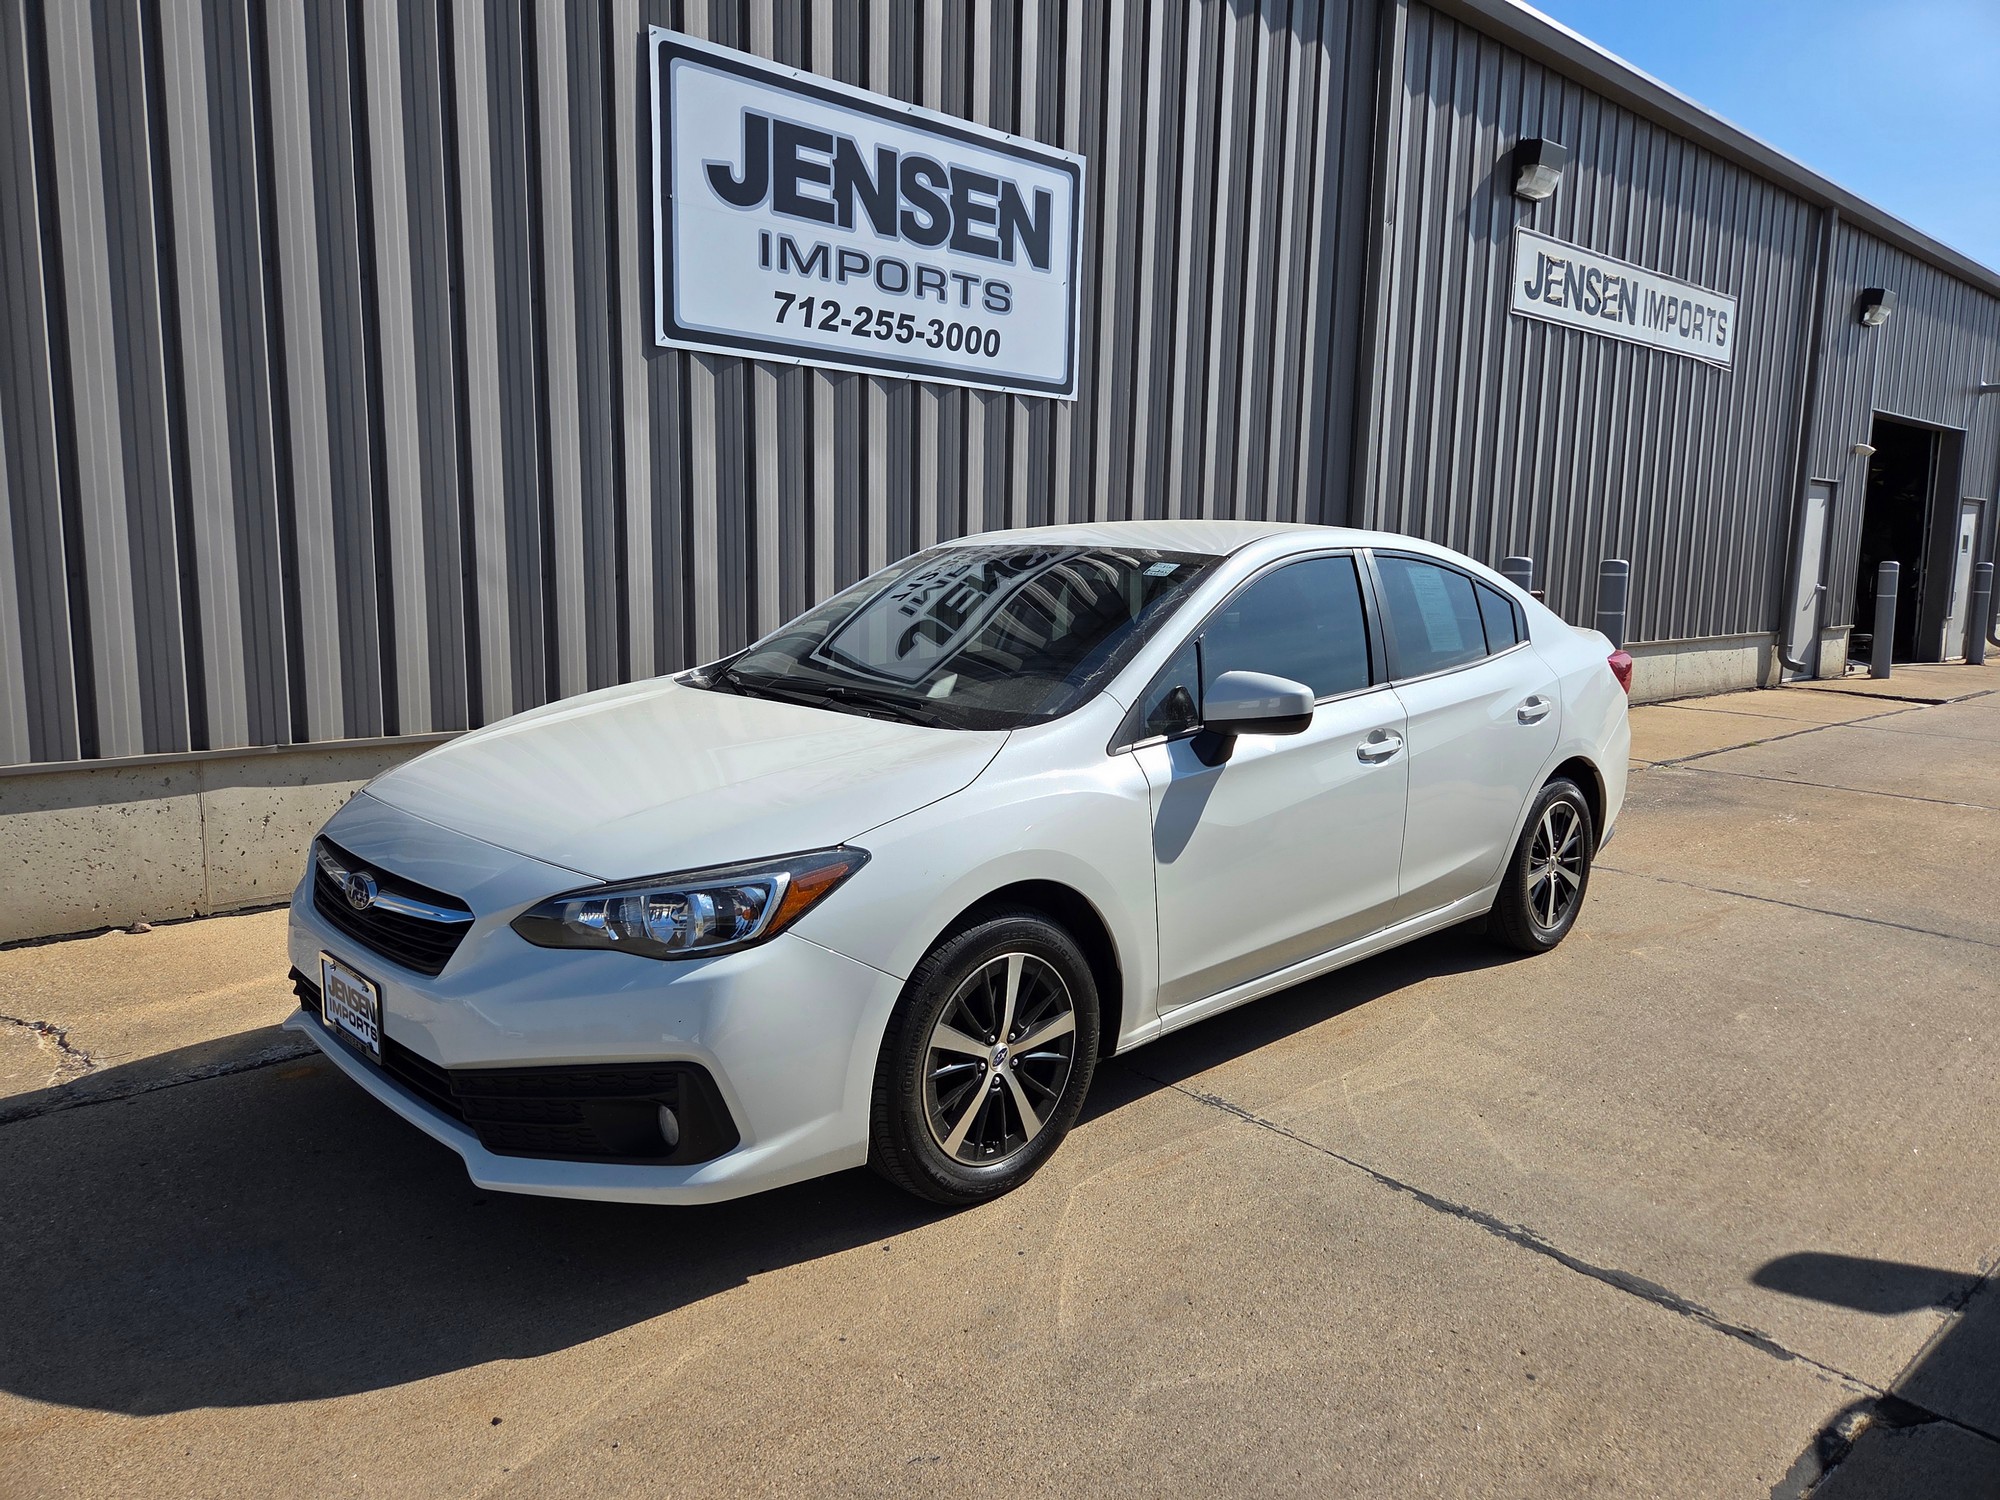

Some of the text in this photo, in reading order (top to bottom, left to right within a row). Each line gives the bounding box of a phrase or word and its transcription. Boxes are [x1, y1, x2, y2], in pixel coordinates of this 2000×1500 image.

[702, 106, 1053, 273] JENSEN
[759, 230, 1013, 315] IMPORTS
[1524, 251, 1728, 347] JENSEN IMPORTS
[774, 291, 1001, 358] 712-255-3000
[328, 975, 377, 1025] JENSEN
[329, 998, 378, 1042] IMPORTS
